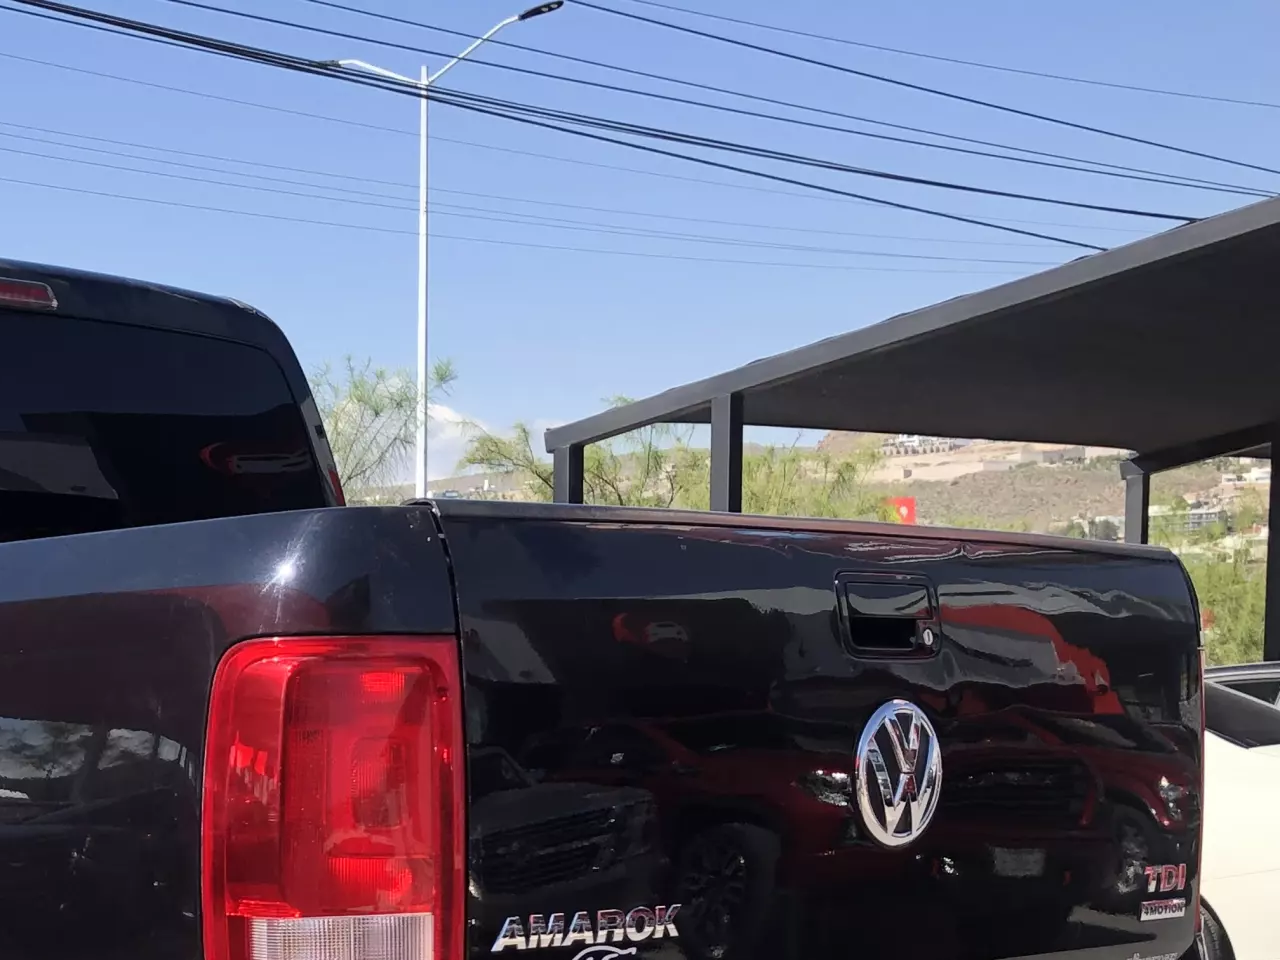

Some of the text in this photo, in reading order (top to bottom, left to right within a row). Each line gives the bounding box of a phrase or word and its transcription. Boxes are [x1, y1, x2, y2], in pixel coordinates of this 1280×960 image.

[1144, 863, 1187, 893] TDI
[1143, 901, 1186, 917] 4MOTION
[491, 904, 682, 952] AMAROK
